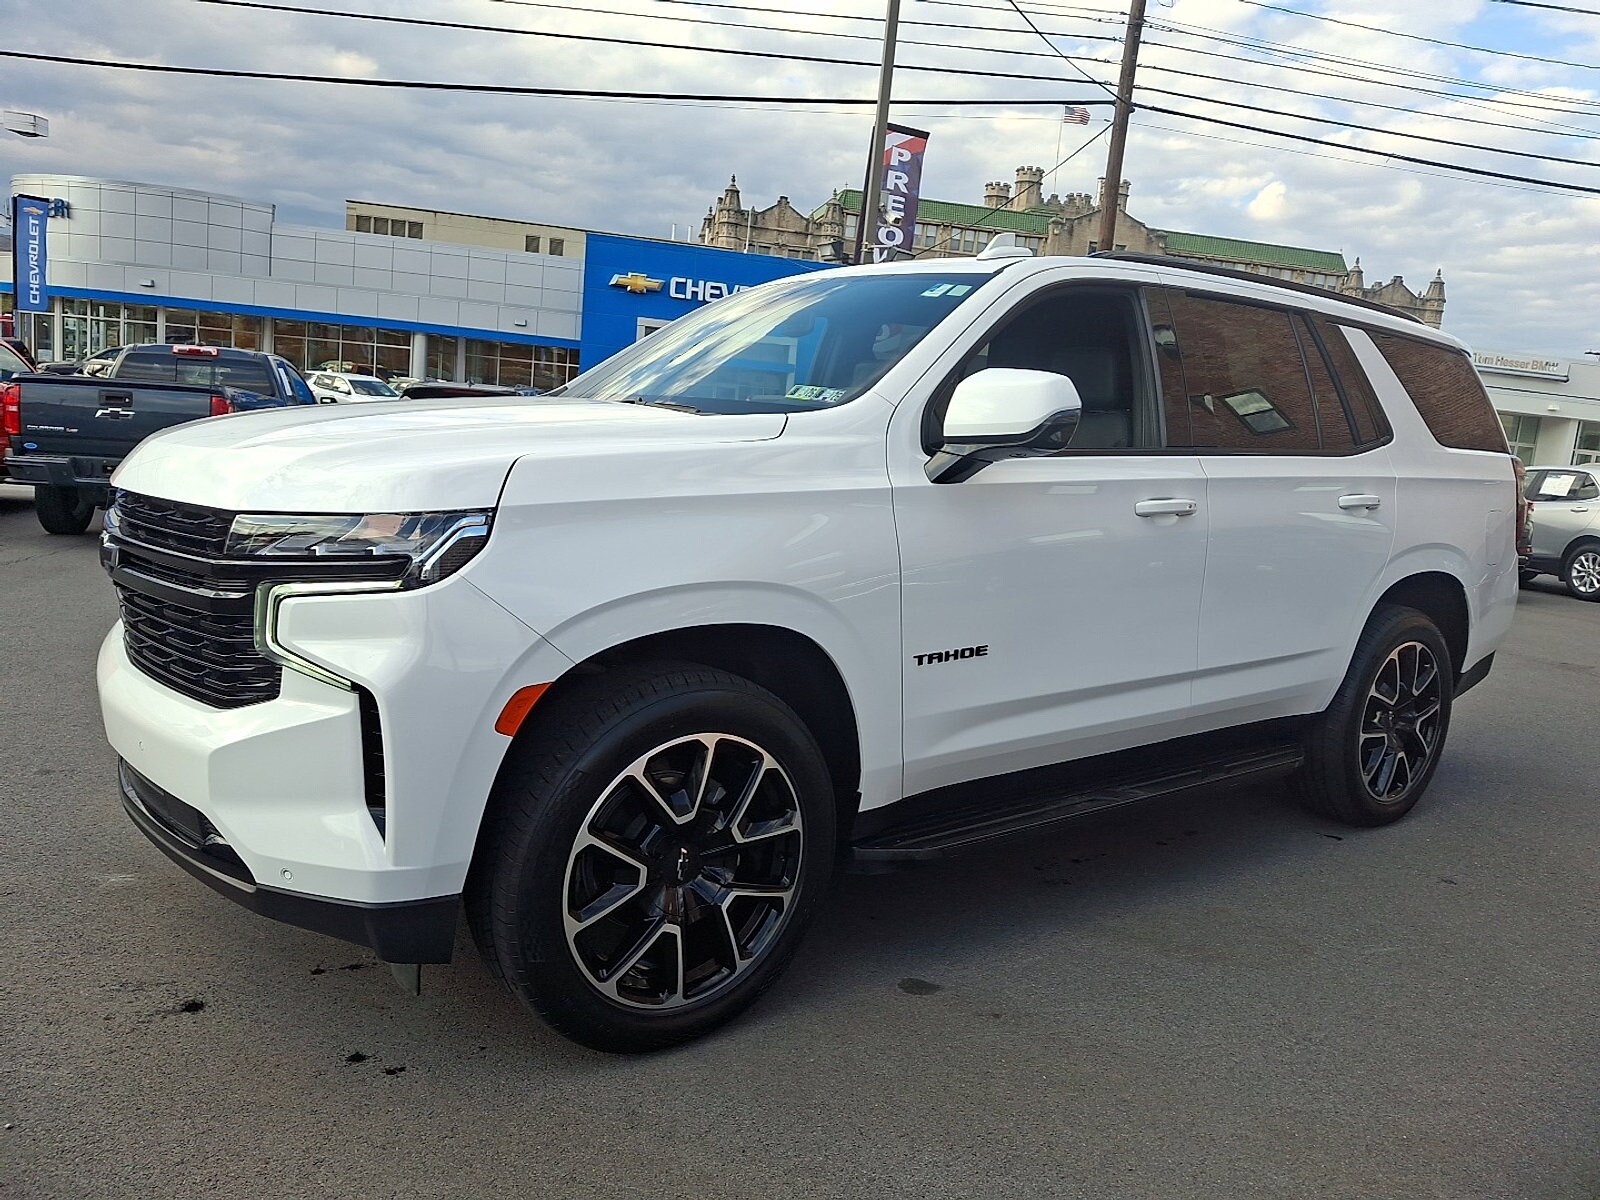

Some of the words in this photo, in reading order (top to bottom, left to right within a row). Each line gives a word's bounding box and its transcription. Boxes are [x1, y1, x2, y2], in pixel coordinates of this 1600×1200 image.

[29, 215, 40, 304] CHEVROLET
[670, 276, 751, 302] CHEV
[1496, 356, 1530, 369] Hesser
[912, 644, 989, 666] TAHOE
